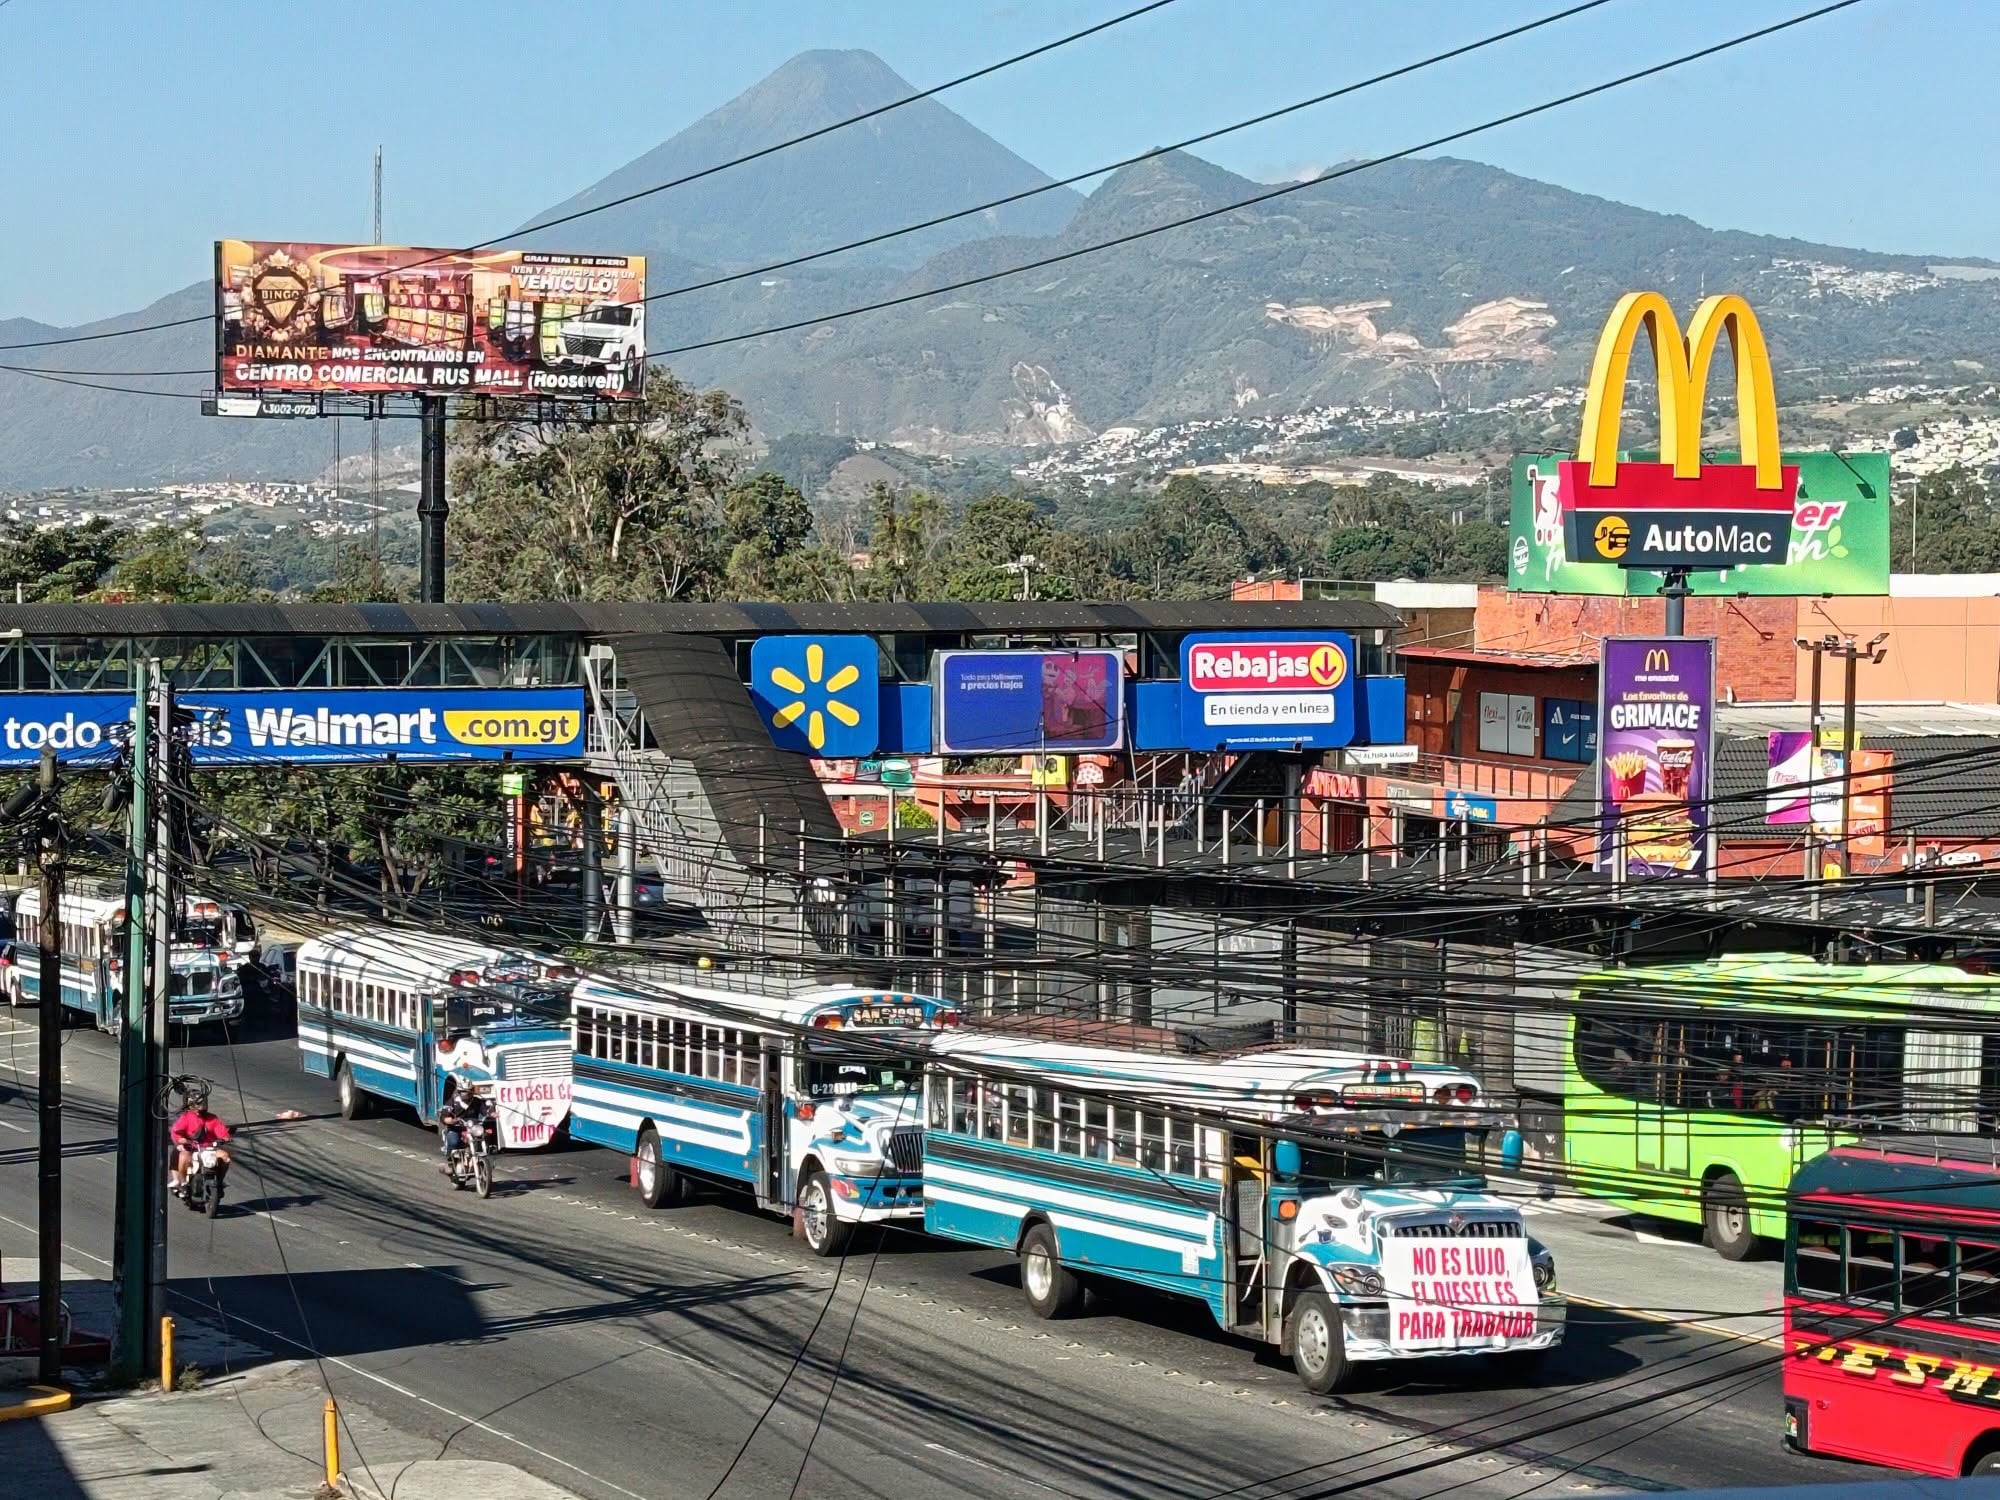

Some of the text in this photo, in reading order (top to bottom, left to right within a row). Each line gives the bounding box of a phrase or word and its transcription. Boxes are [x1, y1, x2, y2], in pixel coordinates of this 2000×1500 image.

[524, 255, 549, 263] GRAN
[581, 257, 594, 265] DE
[595, 258, 626, 266] ENERO
[535, 267, 543, 275] Y
[545, 267, 595, 278] PARTICIPA
[597, 269, 619, 279] POR
[620, 271, 636, 280] UN
[261, 289, 300, 300] BINGO
[235, 345, 328, 359] DIAMANTE
[332, 347, 485, 363] NOS ENCONTRAMOS EN
[235, 363, 625, 391] CENTRO COMERCIAL RUS MALL (Roosevelt)
[1643, 523, 1772, 553] AutoMac
[1195, 650, 1310, 683] Rebajas
[968, 681, 999, 691] precios
[1623, 691, 1689, 701] Los favoritos de
[1210, 704, 1226, 716] En
[1230, 703, 1269, 715] tienda
[1272, 705, 1279, 718] y
[1282, 704, 1297, 714] en
[1610, 703, 1701, 729] GRIMACE
[3, 711, 101, 749] todo
[244, 706, 437, 747] Walmart
[460, 715, 569, 743] .com.gt
[512, 1124, 544, 1143] TODO
[1412, 1247, 1510, 1278] NO ES LUJO,
[1412, 1281, 1519, 1307] EL DIESEL ES
[1399, 1311, 1535, 1341] PARA TRABAJAR
